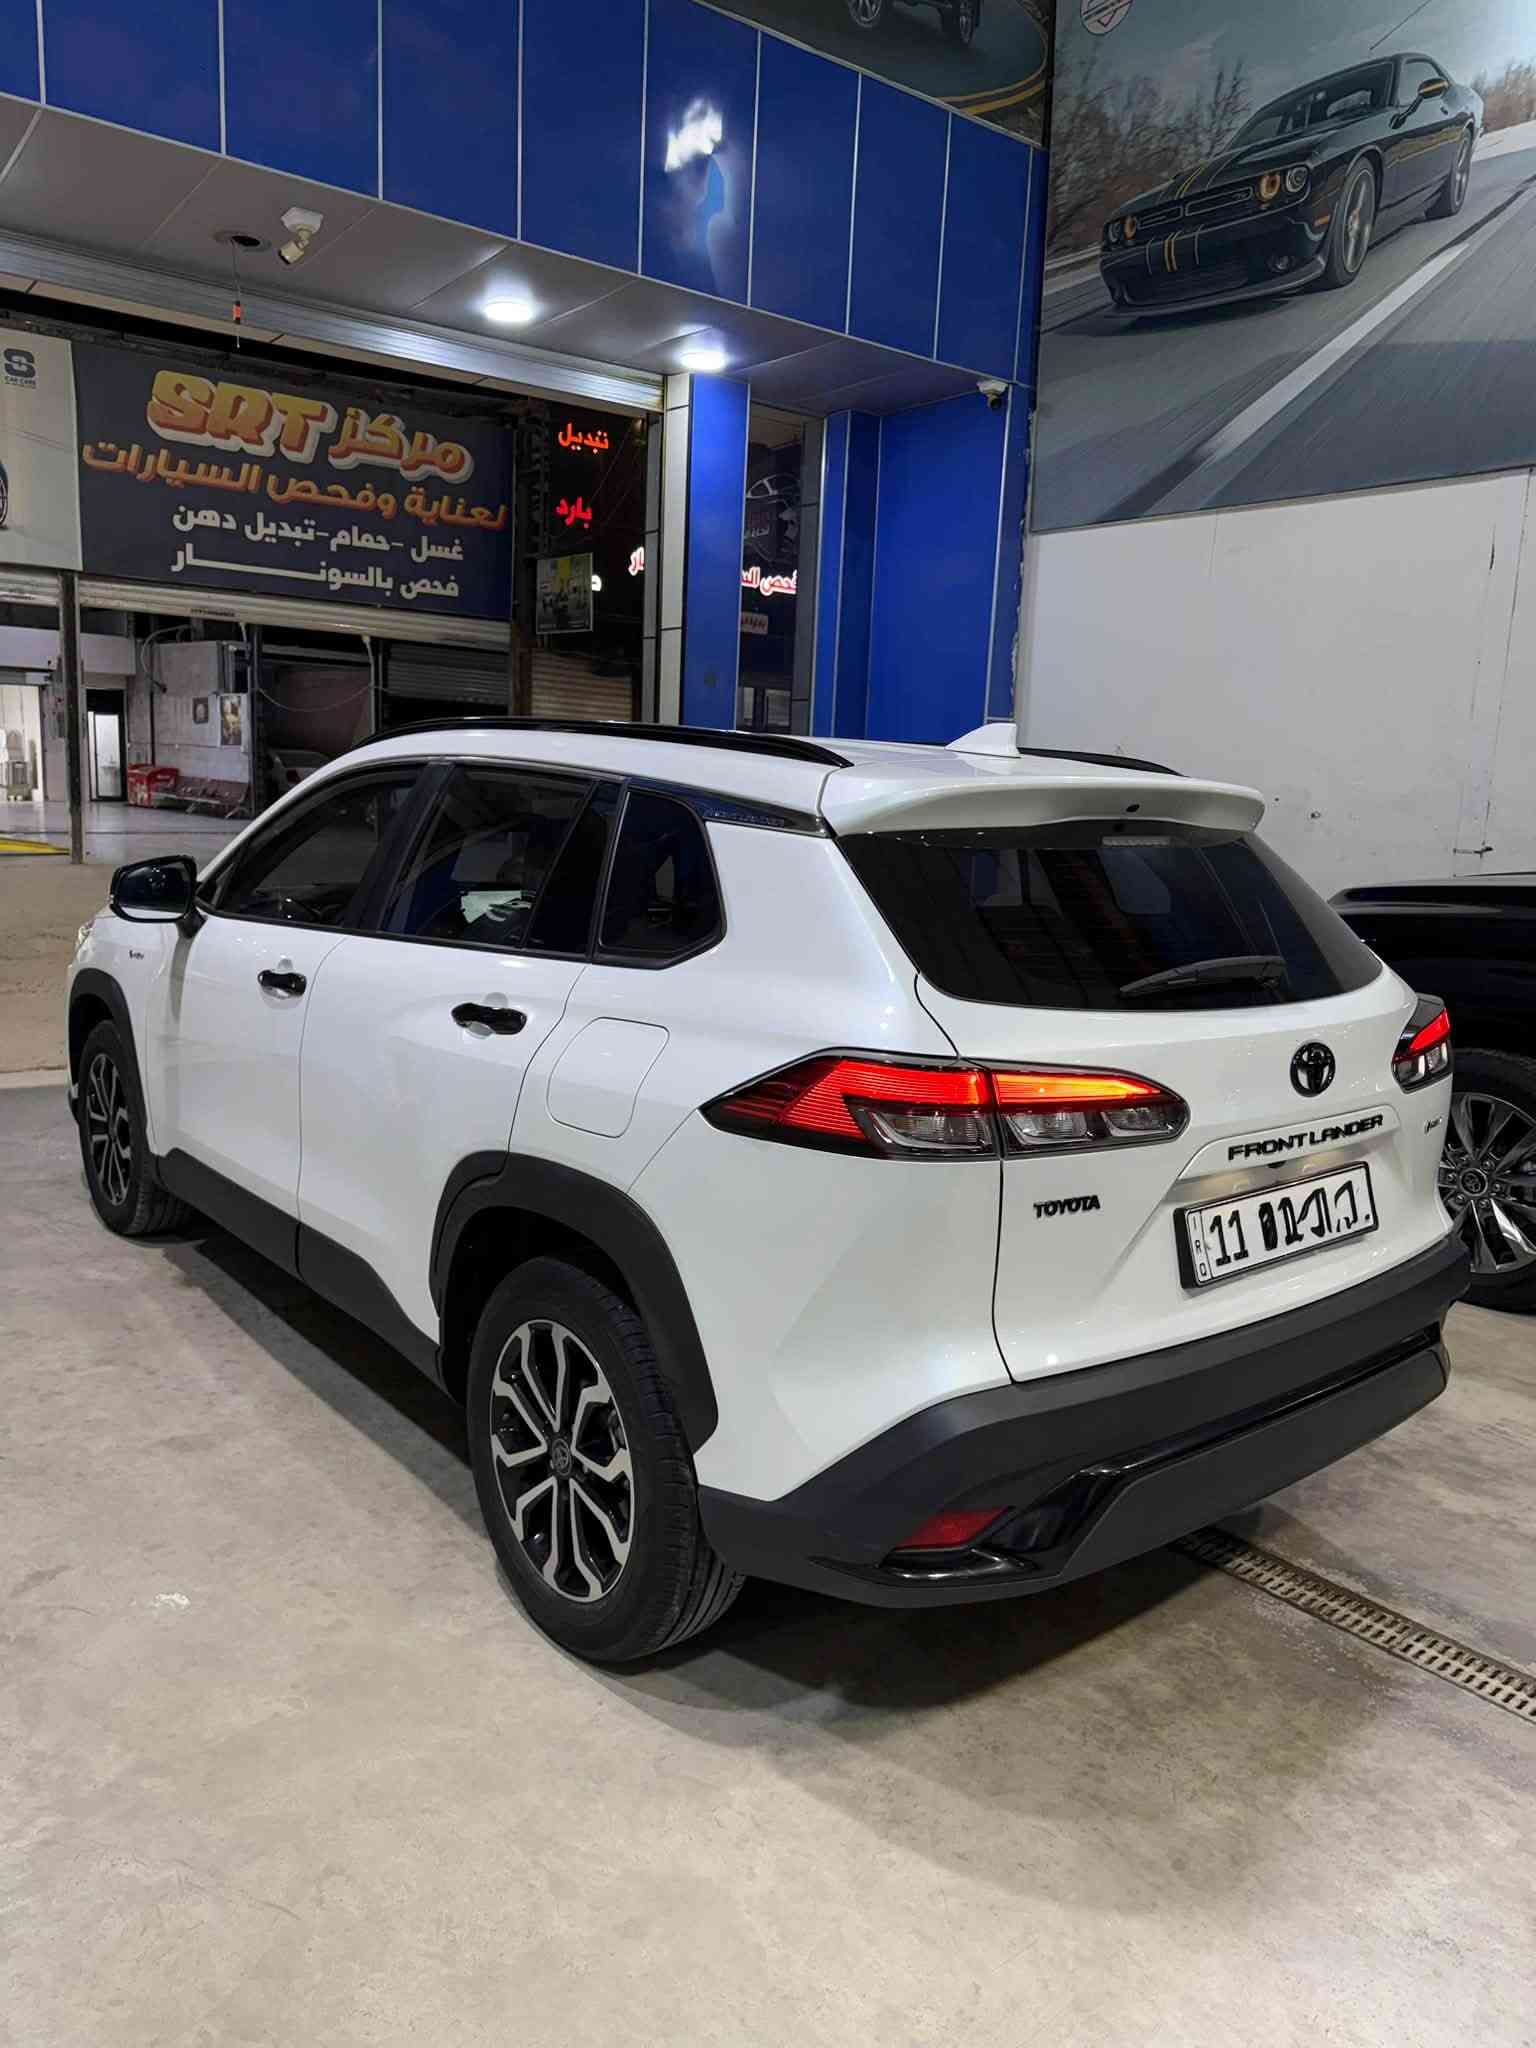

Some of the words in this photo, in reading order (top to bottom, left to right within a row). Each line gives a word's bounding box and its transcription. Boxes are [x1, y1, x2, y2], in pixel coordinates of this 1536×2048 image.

[147, 370, 338, 464] SRT
[83, 442, 262, 493] السيارات
[328, 407, 474, 484] مركز
[172, 505, 237, 532] دهن
[266, 474, 396, 520] وفحص
[404, 486, 508, 528] لعناية
[410, 536, 464, 563] غسل
[400, 576, 459, 599] فحص
[1033, 1195, 1101, 1218] TOYOTA
[1209, 1209, 1249, 1266] 11
